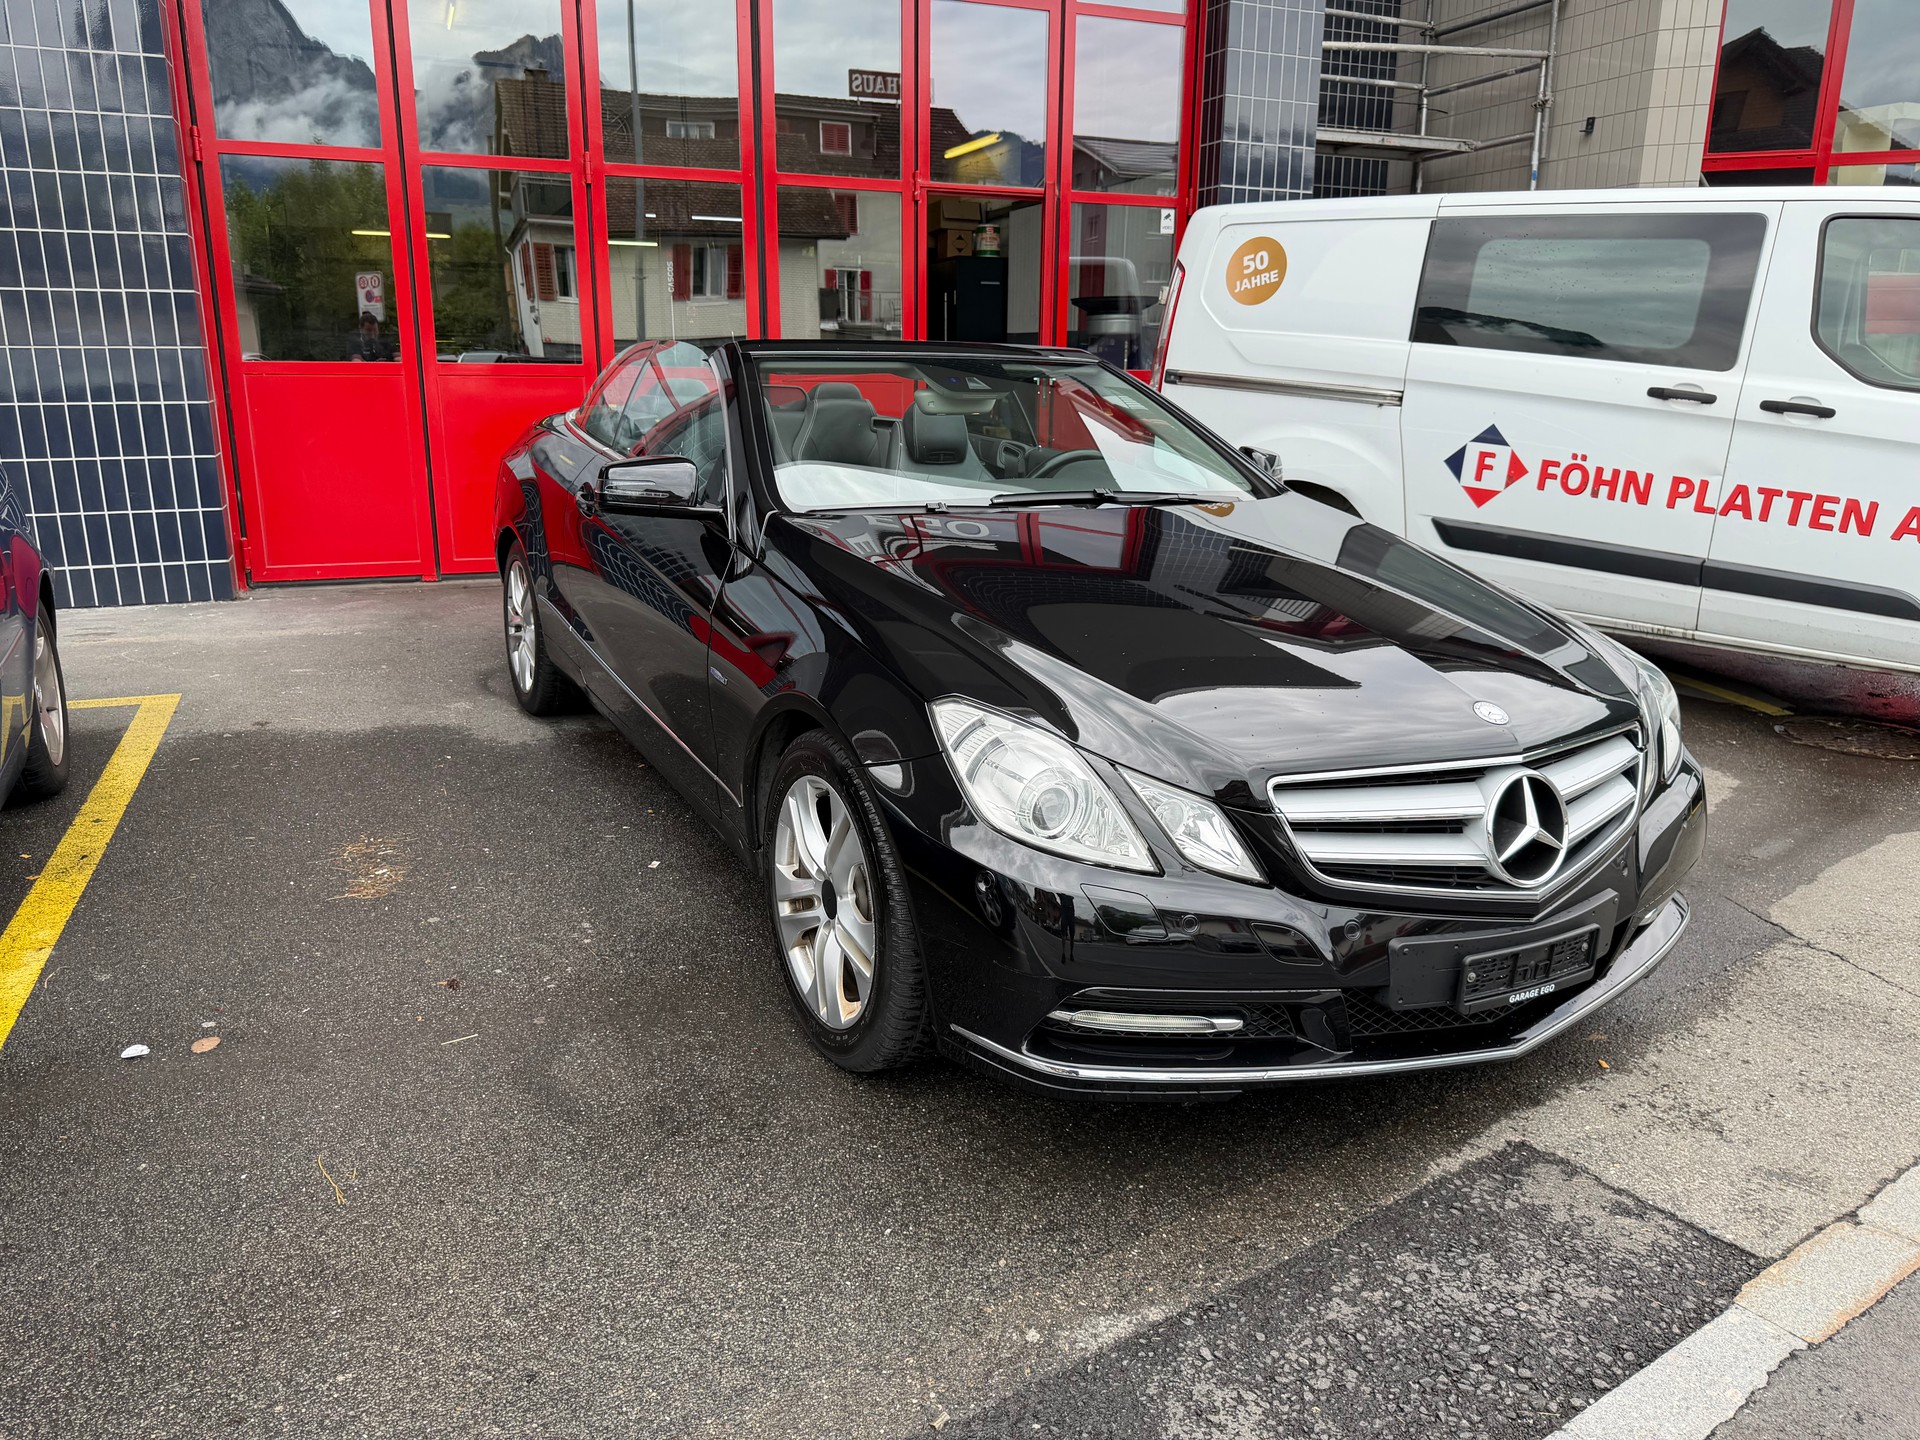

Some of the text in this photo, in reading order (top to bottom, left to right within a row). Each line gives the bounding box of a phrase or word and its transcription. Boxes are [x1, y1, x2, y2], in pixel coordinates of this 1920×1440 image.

[1243, 250, 1269, 275] 50
[1234, 269, 1279, 293] JAHRE
[1474, 450, 1497, 482] F
[1536, 453, 1654, 506] FÖHN
[1666, 475, 1880, 537] PLATTEN
[1509, 984, 1555, 1003] GARAGE EGO
